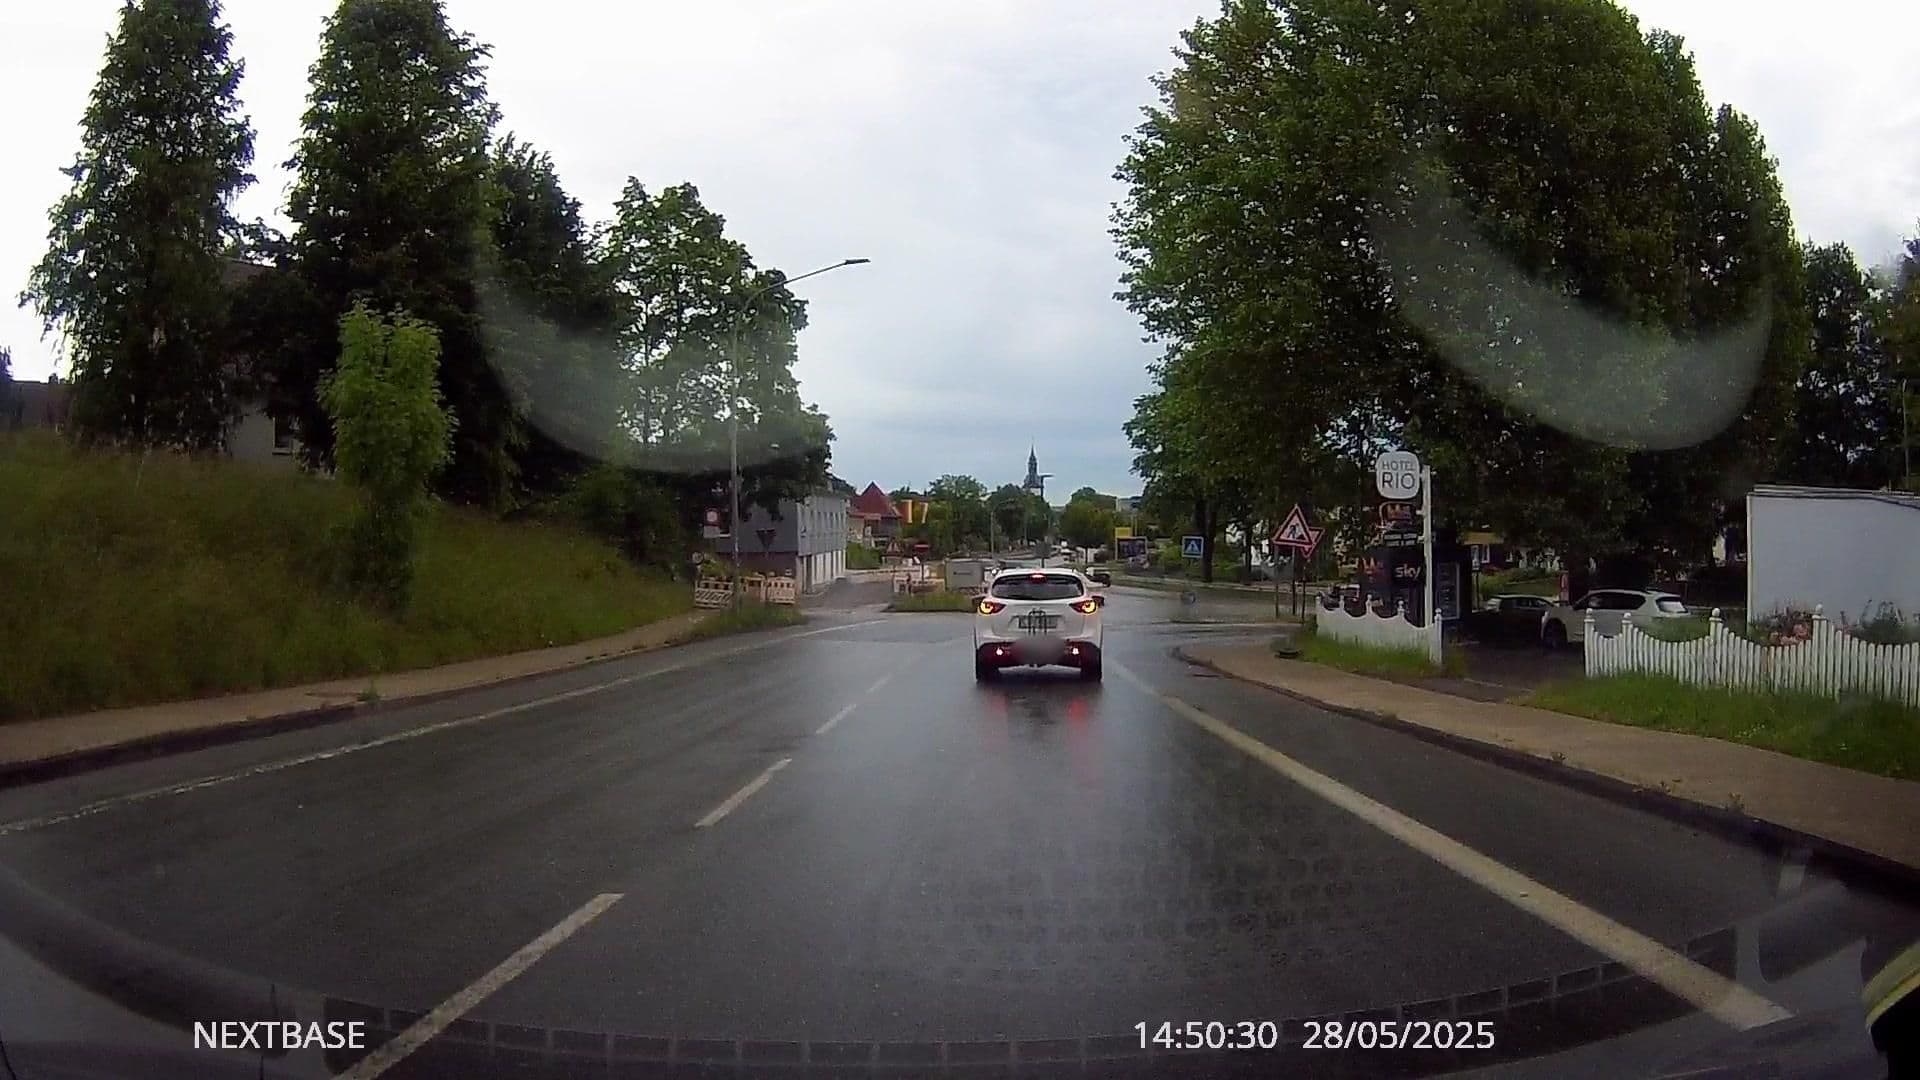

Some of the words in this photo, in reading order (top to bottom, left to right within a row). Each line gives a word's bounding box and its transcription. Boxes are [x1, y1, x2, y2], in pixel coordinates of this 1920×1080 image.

[1382, 460, 1416, 471] HOTEL
[1382, 471, 1416, 490] RIO
[1395, 563, 1421, 581] sky
